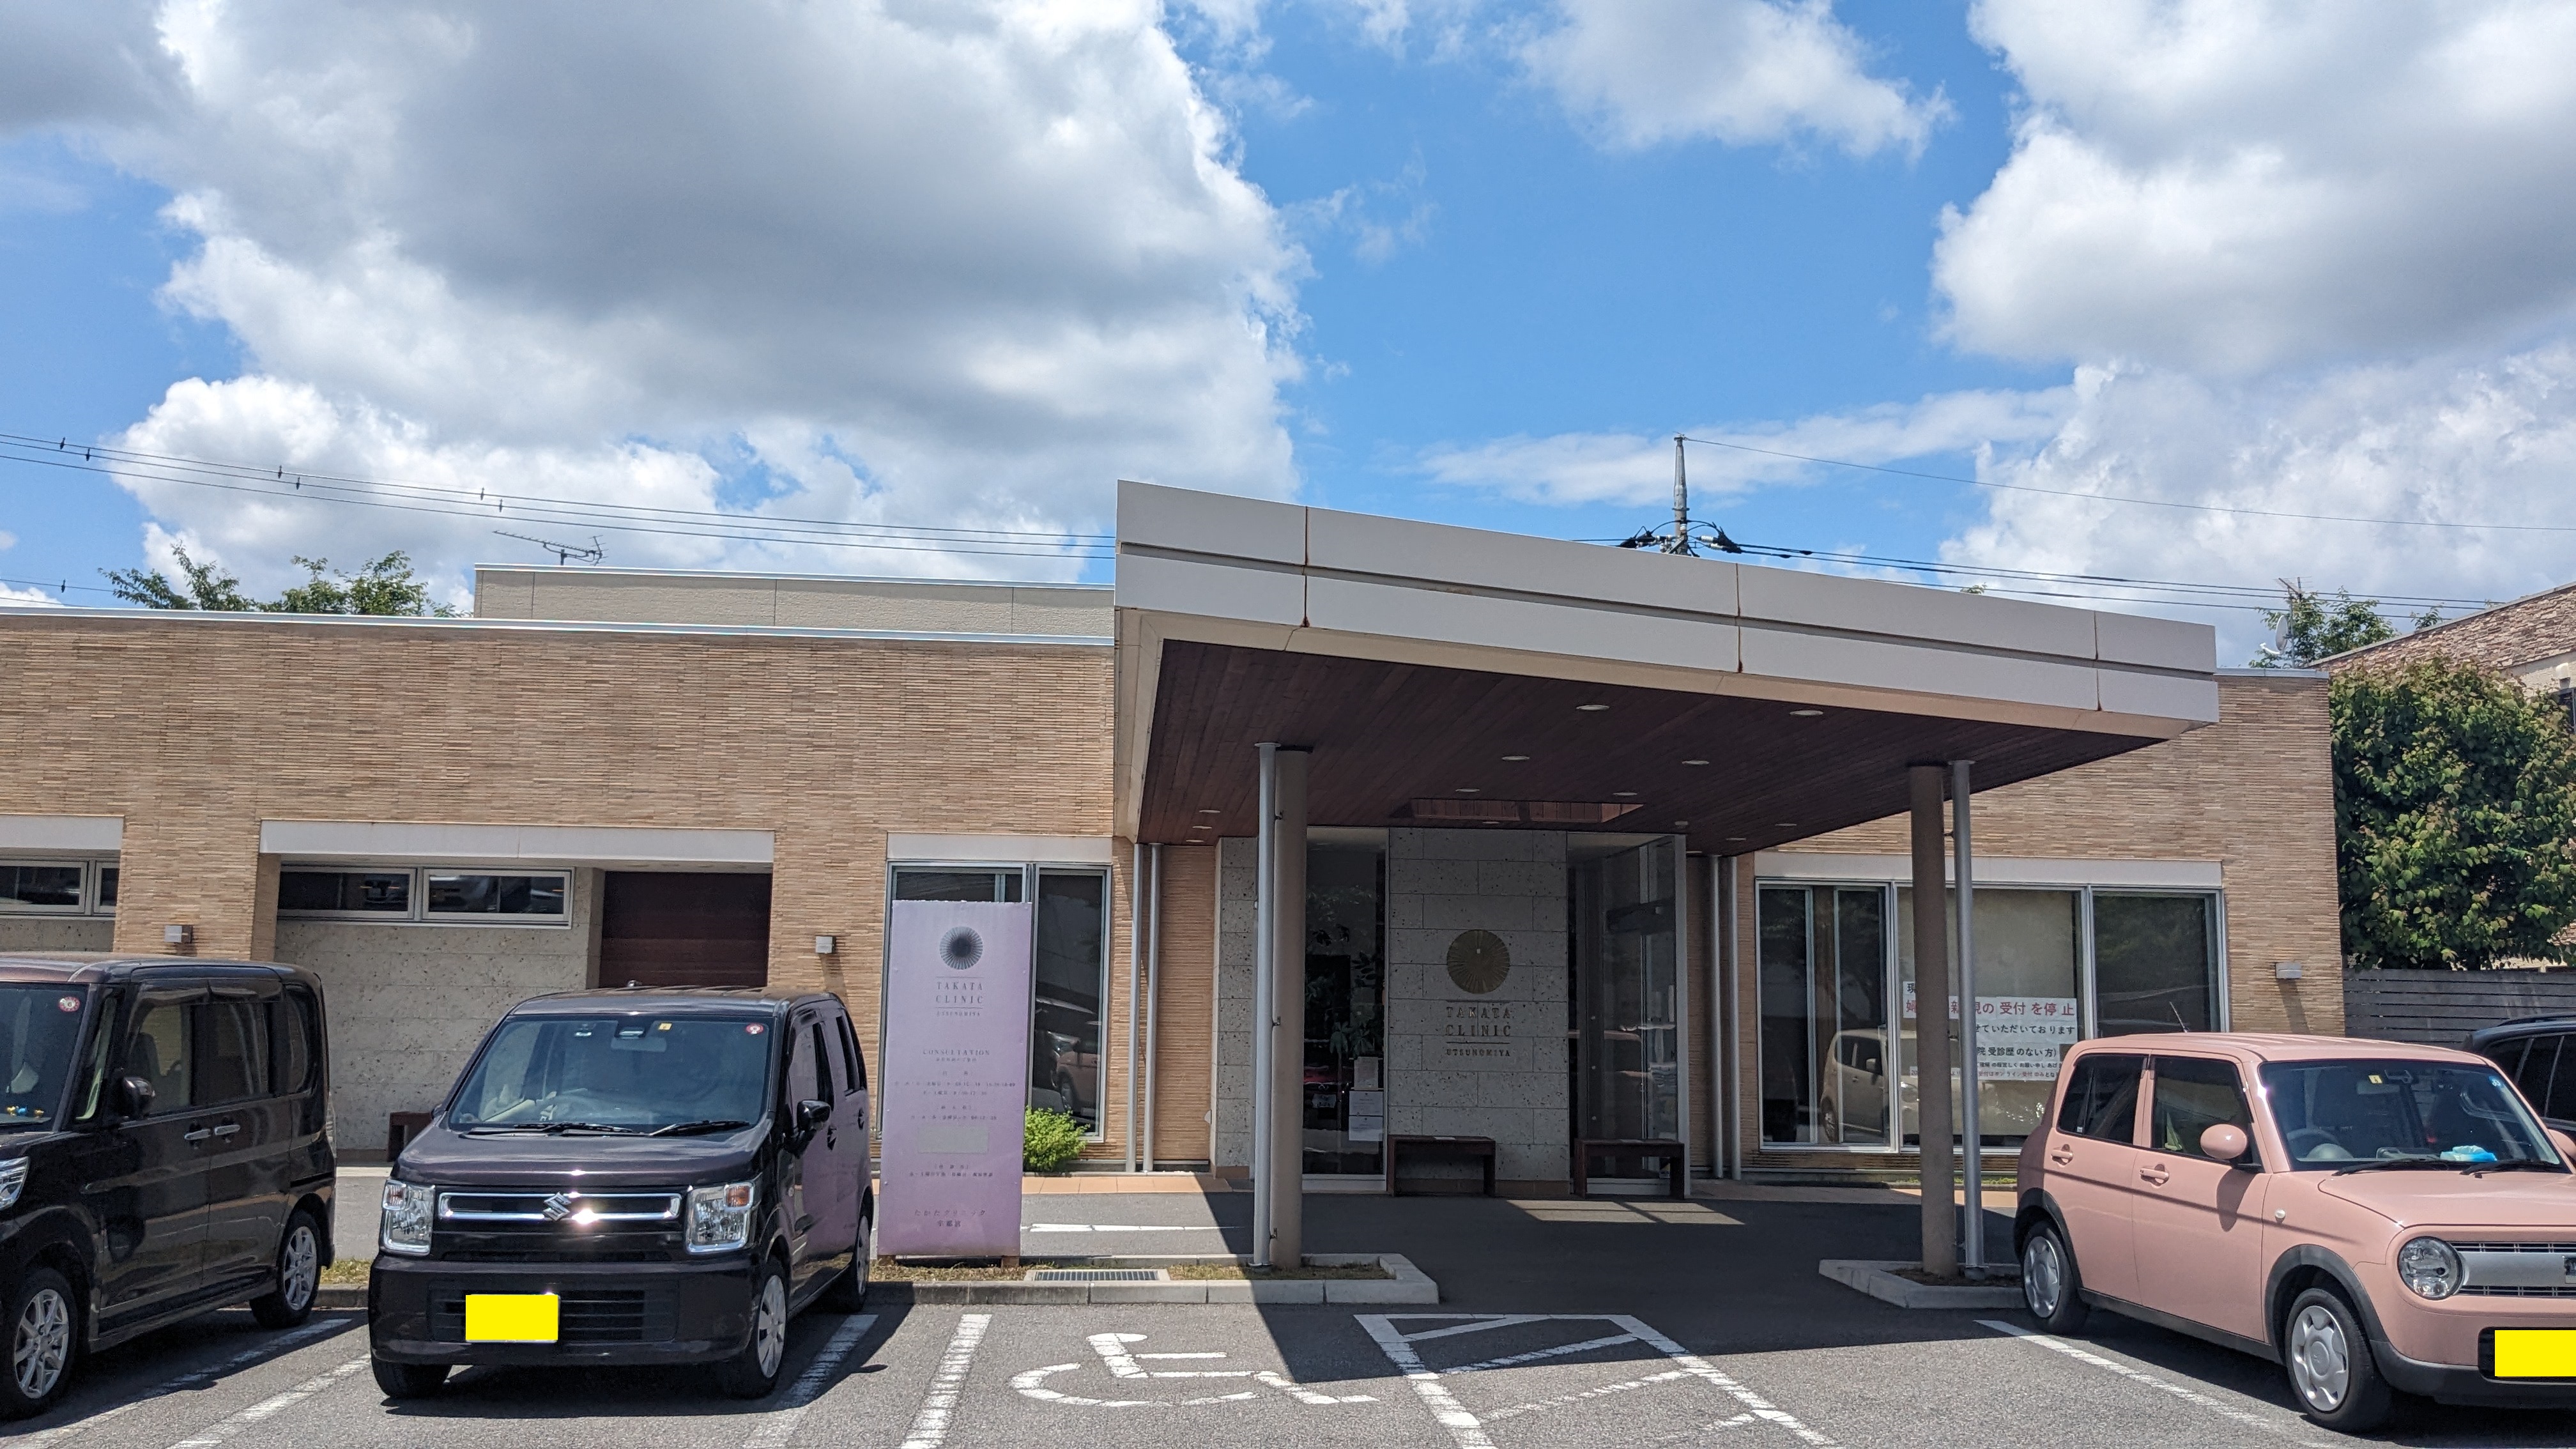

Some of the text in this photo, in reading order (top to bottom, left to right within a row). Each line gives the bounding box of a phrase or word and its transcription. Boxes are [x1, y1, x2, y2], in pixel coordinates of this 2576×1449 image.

[937, 981, 983, 990] TAKATA
[935, 995, 983, 1004] CLINIC
[1446, 1006, 1510, 1019] TAKATA
[1445, 1024, 1511, 1037] CLINIC
[1446, 1048, 1510, 1057] UTSUNOMIYA
